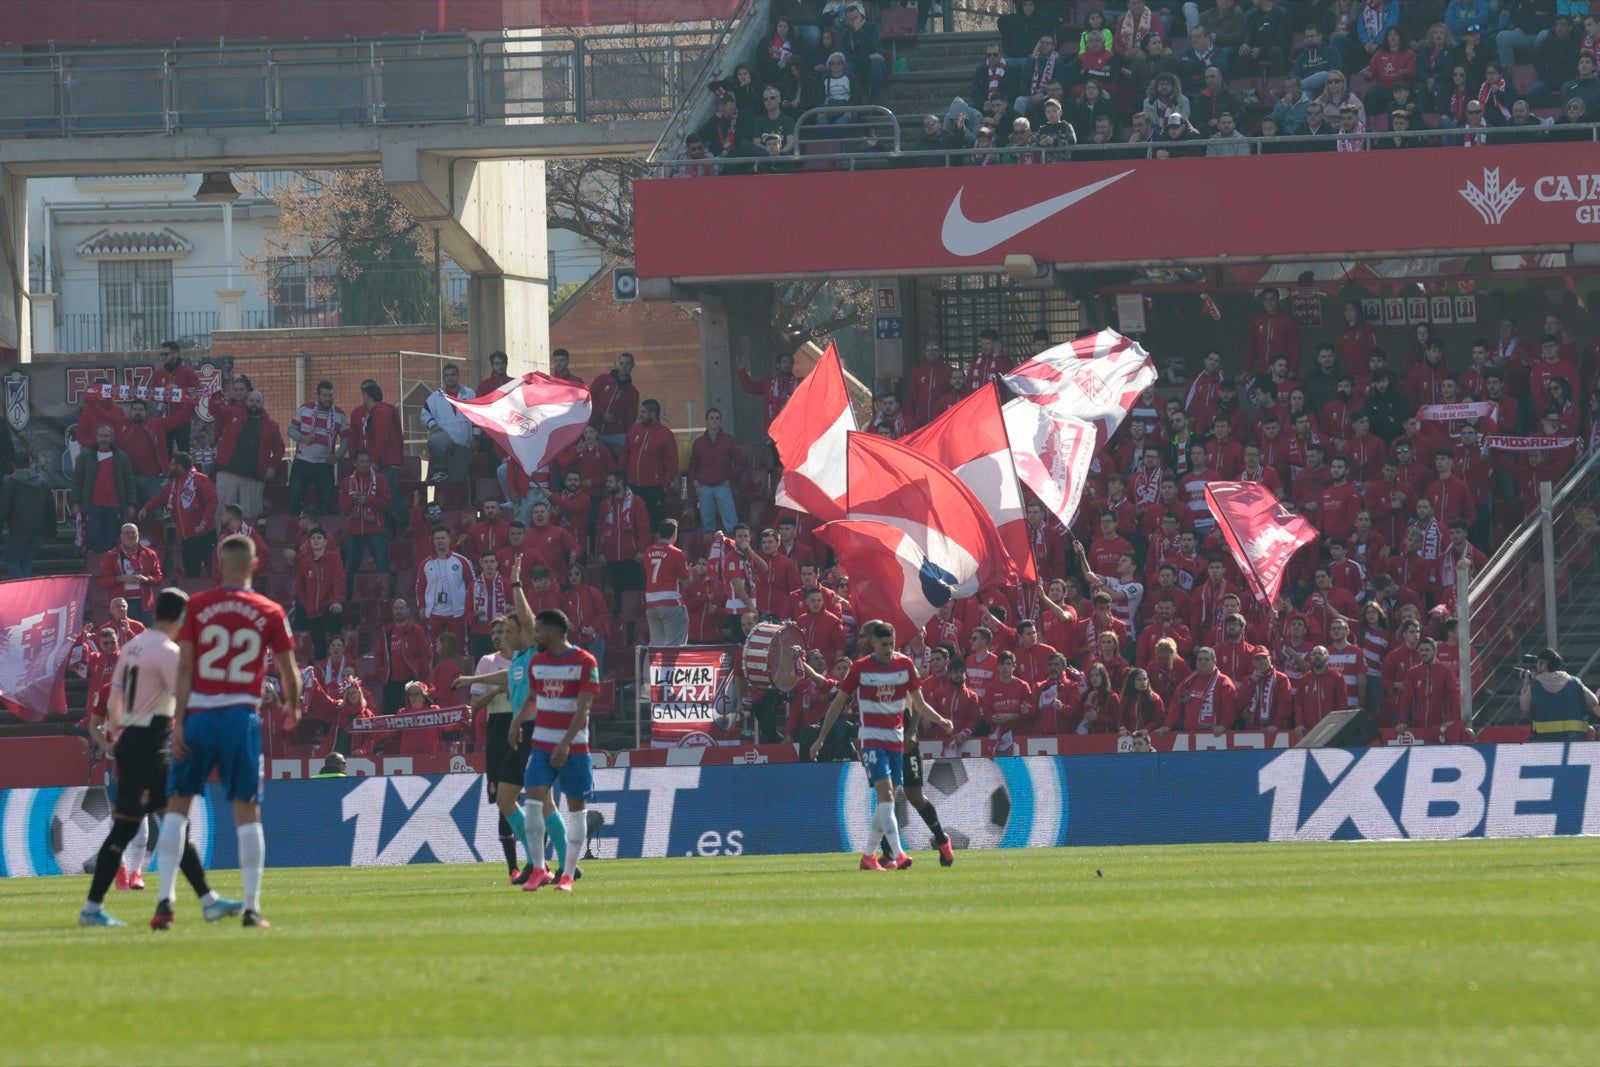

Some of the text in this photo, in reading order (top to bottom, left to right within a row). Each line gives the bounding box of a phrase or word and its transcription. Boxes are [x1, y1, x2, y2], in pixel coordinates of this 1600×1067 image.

[650, 558, 662, 583] 7
[199, 624, 261, 684] 22
[654, 667, 713, 685] LUCHAR
[122, 664, 139, 713] 11
[663, 685, 711, 702] PARA
[652, 703, 711, 720] GANAR
[909, 756, 919, 772] 5
